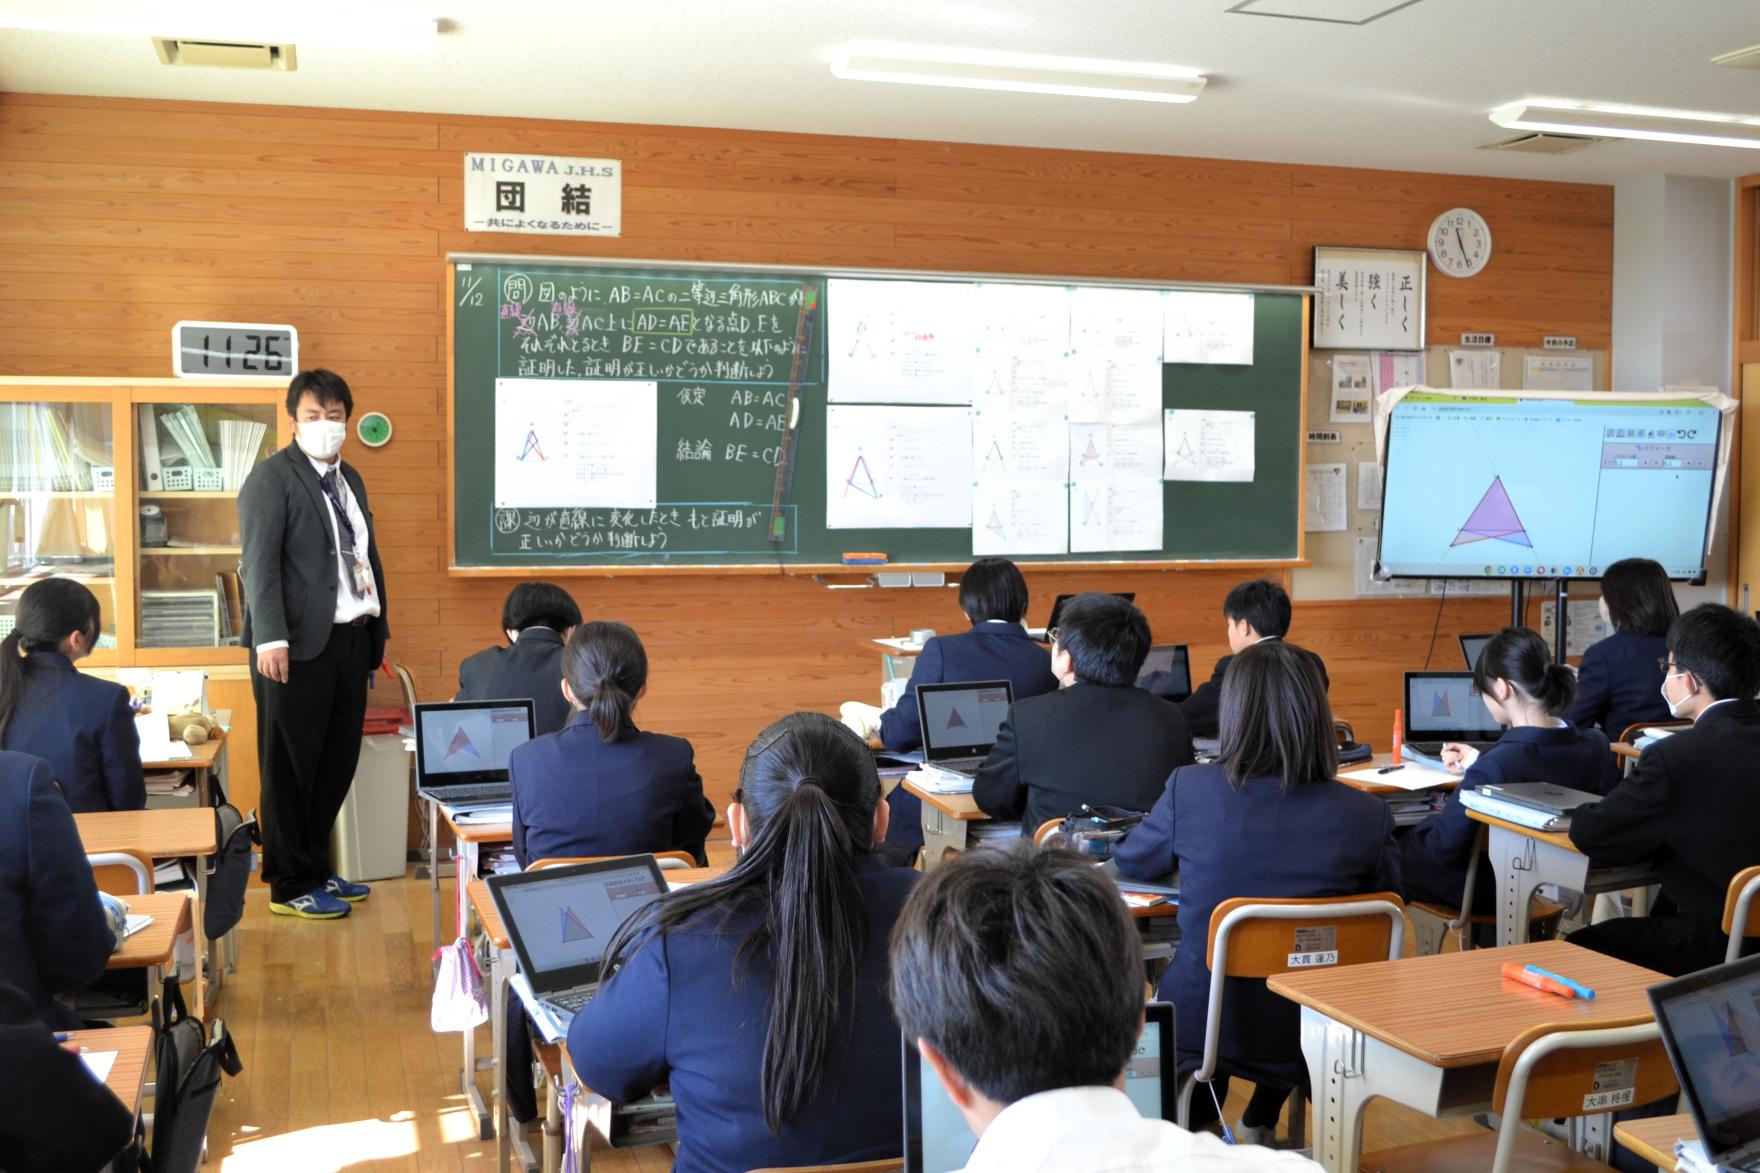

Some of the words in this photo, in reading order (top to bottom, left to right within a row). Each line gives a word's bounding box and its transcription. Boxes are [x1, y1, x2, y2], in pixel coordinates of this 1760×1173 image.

[471, 157, 558, 175] MIGAWA
[563, 165, 614, 178] J.H.S
[496, 181, 525, 212] 団
[561, 183, 592, 215] 結
[506, 275, 530, 304] 問
[1336, 271, 1348, 331] 美しく
[1368, 272, 1381, 310] 強く
[1399, 275, 1413, 333] 正しく
[677, 386, 706, 406] 仮定
[676, 437, 712, 462] 結論
[497, 508, 519, 531] 課
